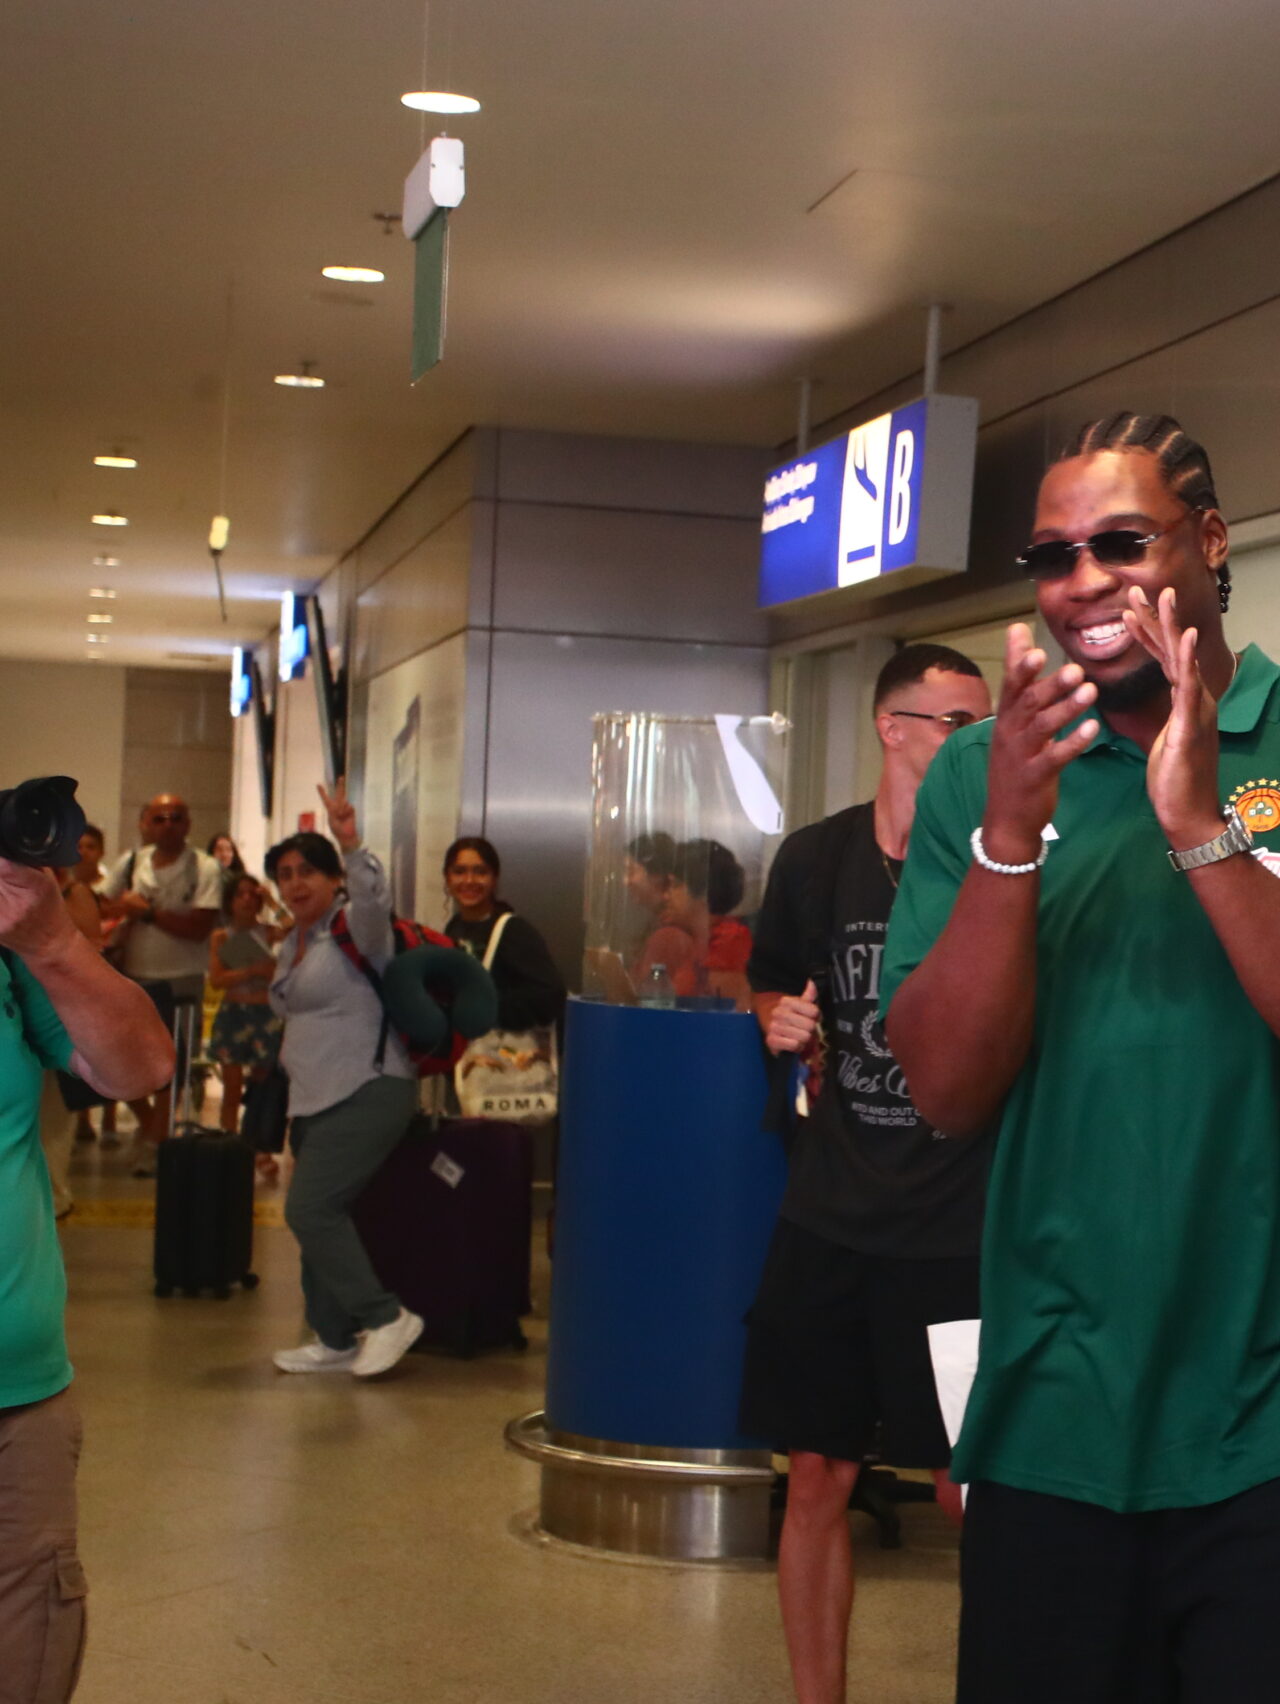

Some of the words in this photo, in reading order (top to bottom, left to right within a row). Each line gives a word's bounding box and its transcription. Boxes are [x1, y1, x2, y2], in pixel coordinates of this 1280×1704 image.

[888, 429, 915, 546] B
[482, 1097, 546, 1111] ROMA
[868, 1105, 889, 1117] AND
[890, 1106, 914, 1117] OUT
[878, 1116, 918, 1127] WORLD
